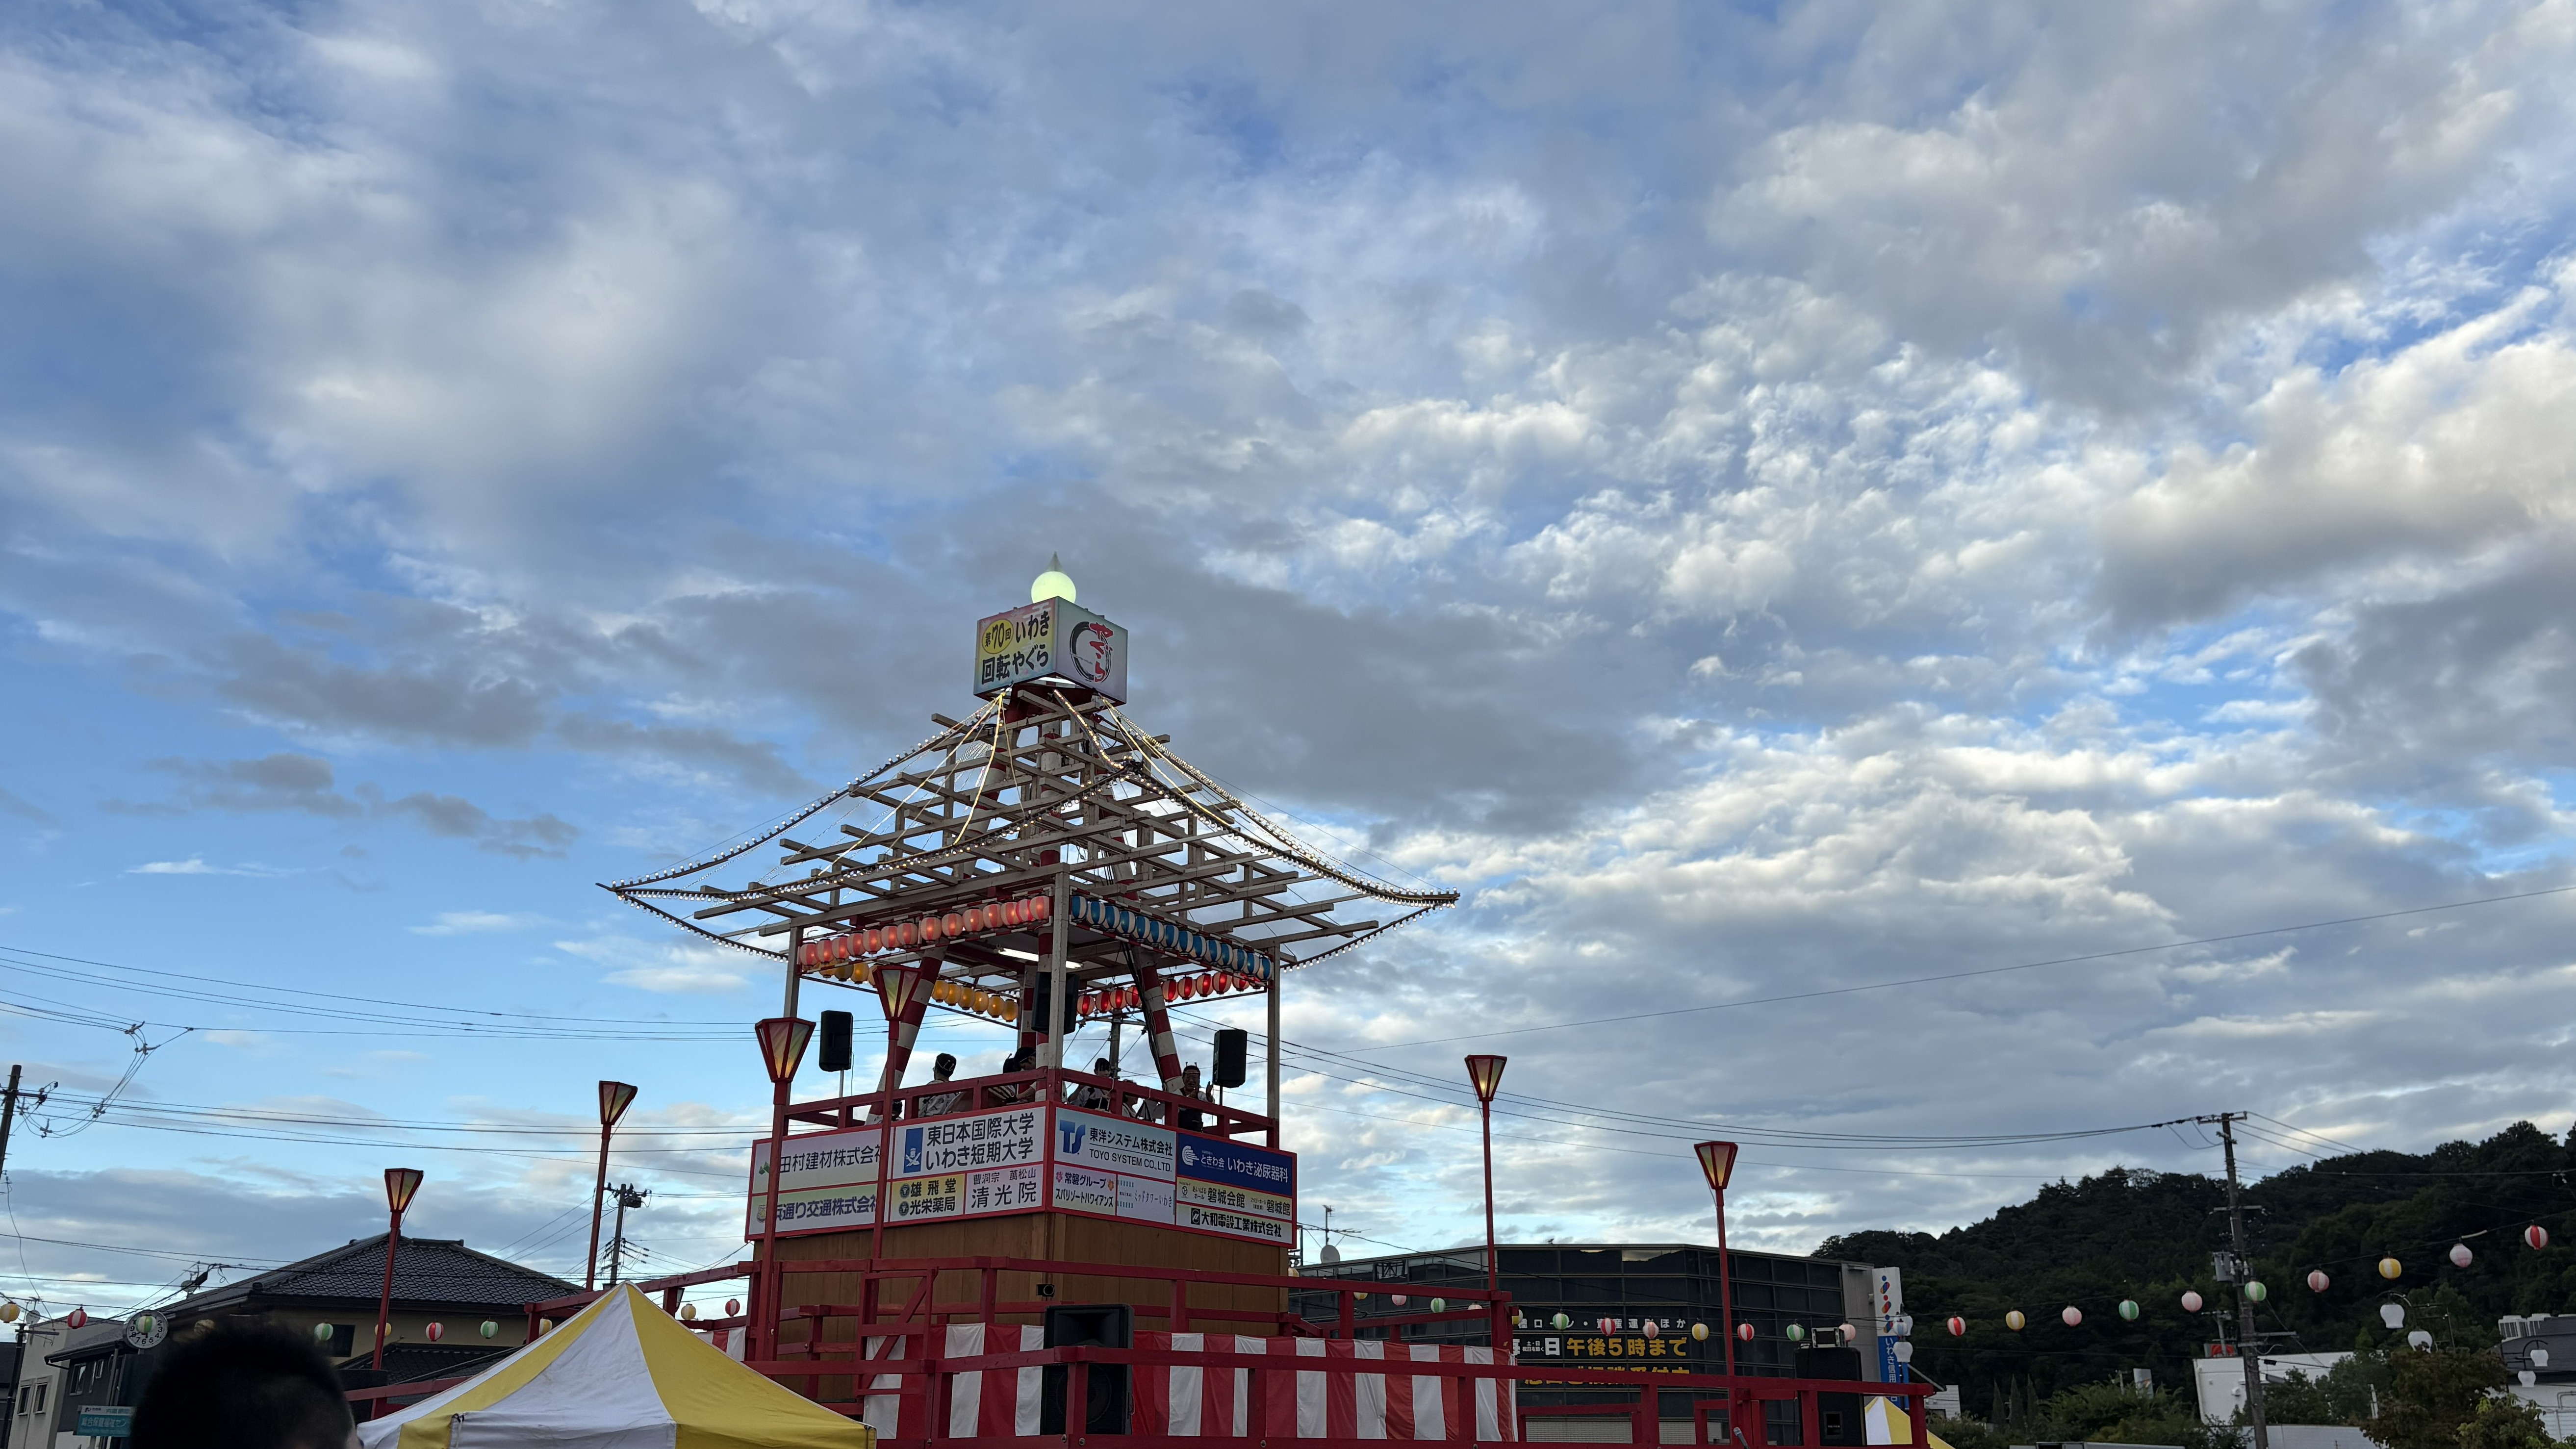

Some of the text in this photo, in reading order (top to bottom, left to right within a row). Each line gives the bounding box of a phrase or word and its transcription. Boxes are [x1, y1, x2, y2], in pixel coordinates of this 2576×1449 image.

[985, 611, 1049, 649] 第70回 いわき
[982, 644, 1049, 684] 回転やぐら
[927, 1112, 1034, 1146] 東日本国際大学
[1090, 1128, 1173, 1156] 東洋システム株式会社
[926, 1137, 1033, 1170] いわき短期大学
[1090, 1149, 1109, 1160] TOYO
[1112, 1153, 1142, 1166] SYSTEM
[973, 1172, 999, 1185] 曹洞宗
[1065, 1172, 1106, 1189] 常磐グループ
[1201, 1154, 1288, 1183] ときわ会 いわき泌尿器科
[911, 1178, 956, 1197] 雄飛堂
[971, 1181, 1037, 1209] 清光院
[1208, 1187, 1245, 1208] 磐城会館
[910, 1196, 955, 1215] 光栄薬局
[1201, 1211, 1281, 1238] 大和電設工業株式会社
